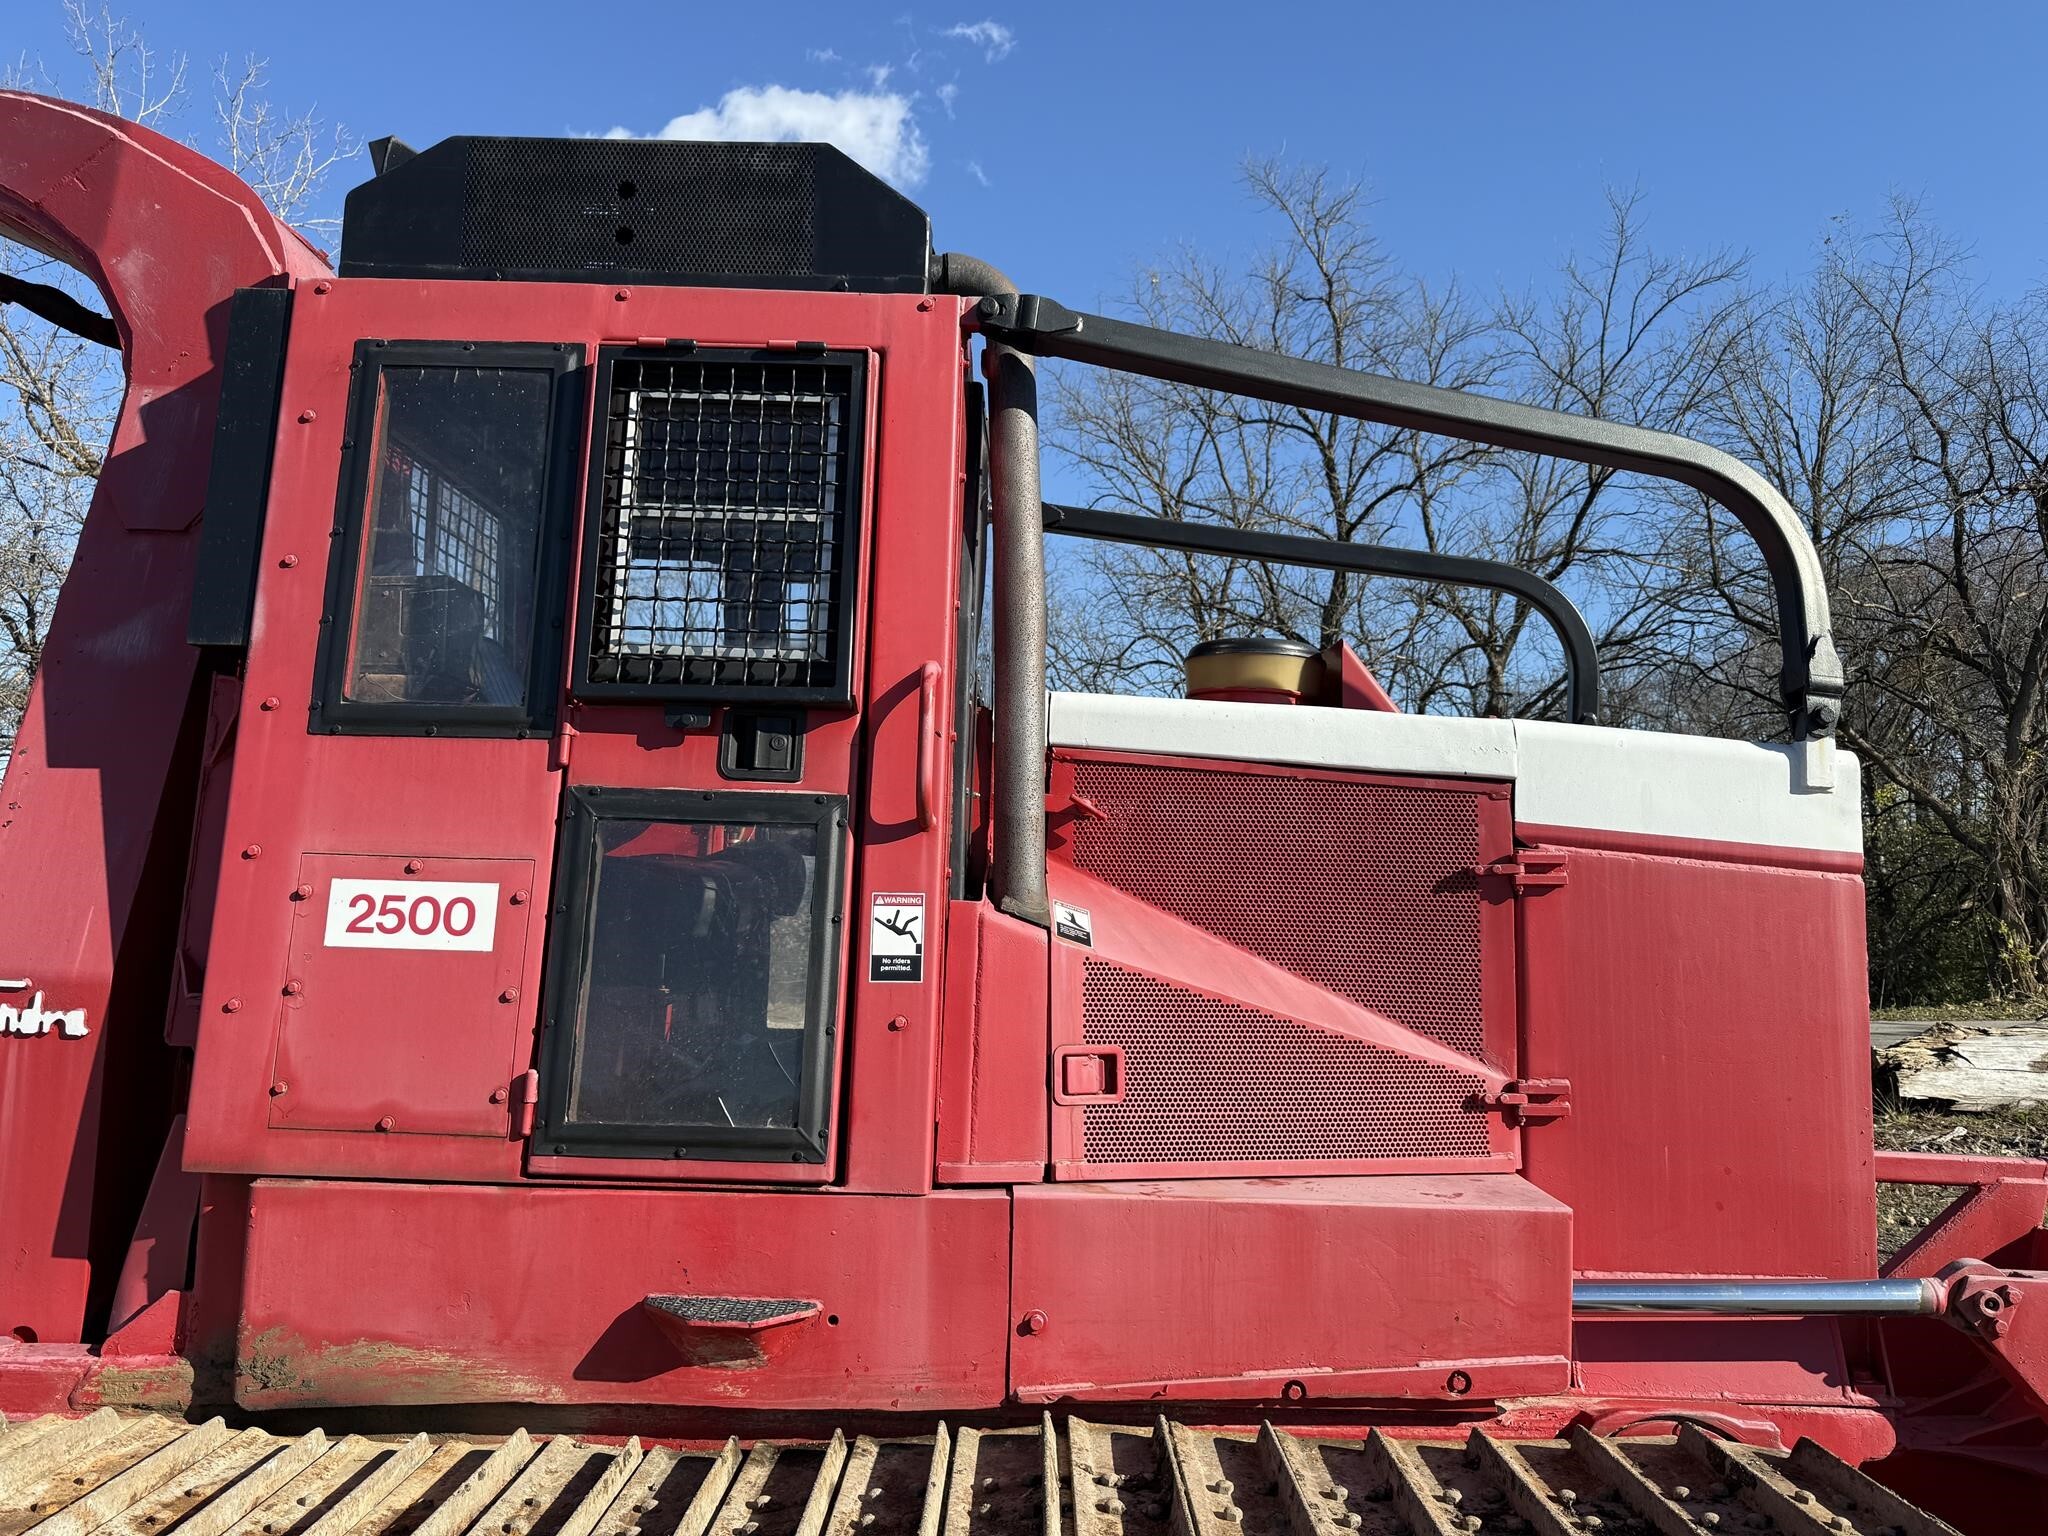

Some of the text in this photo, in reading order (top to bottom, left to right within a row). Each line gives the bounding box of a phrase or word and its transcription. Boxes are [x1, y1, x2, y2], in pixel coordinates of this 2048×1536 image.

[345, 893, 476, 937] 2500
[883, 895, 922, 904] WARNING
[0, 982, 90, 1037] ndra
